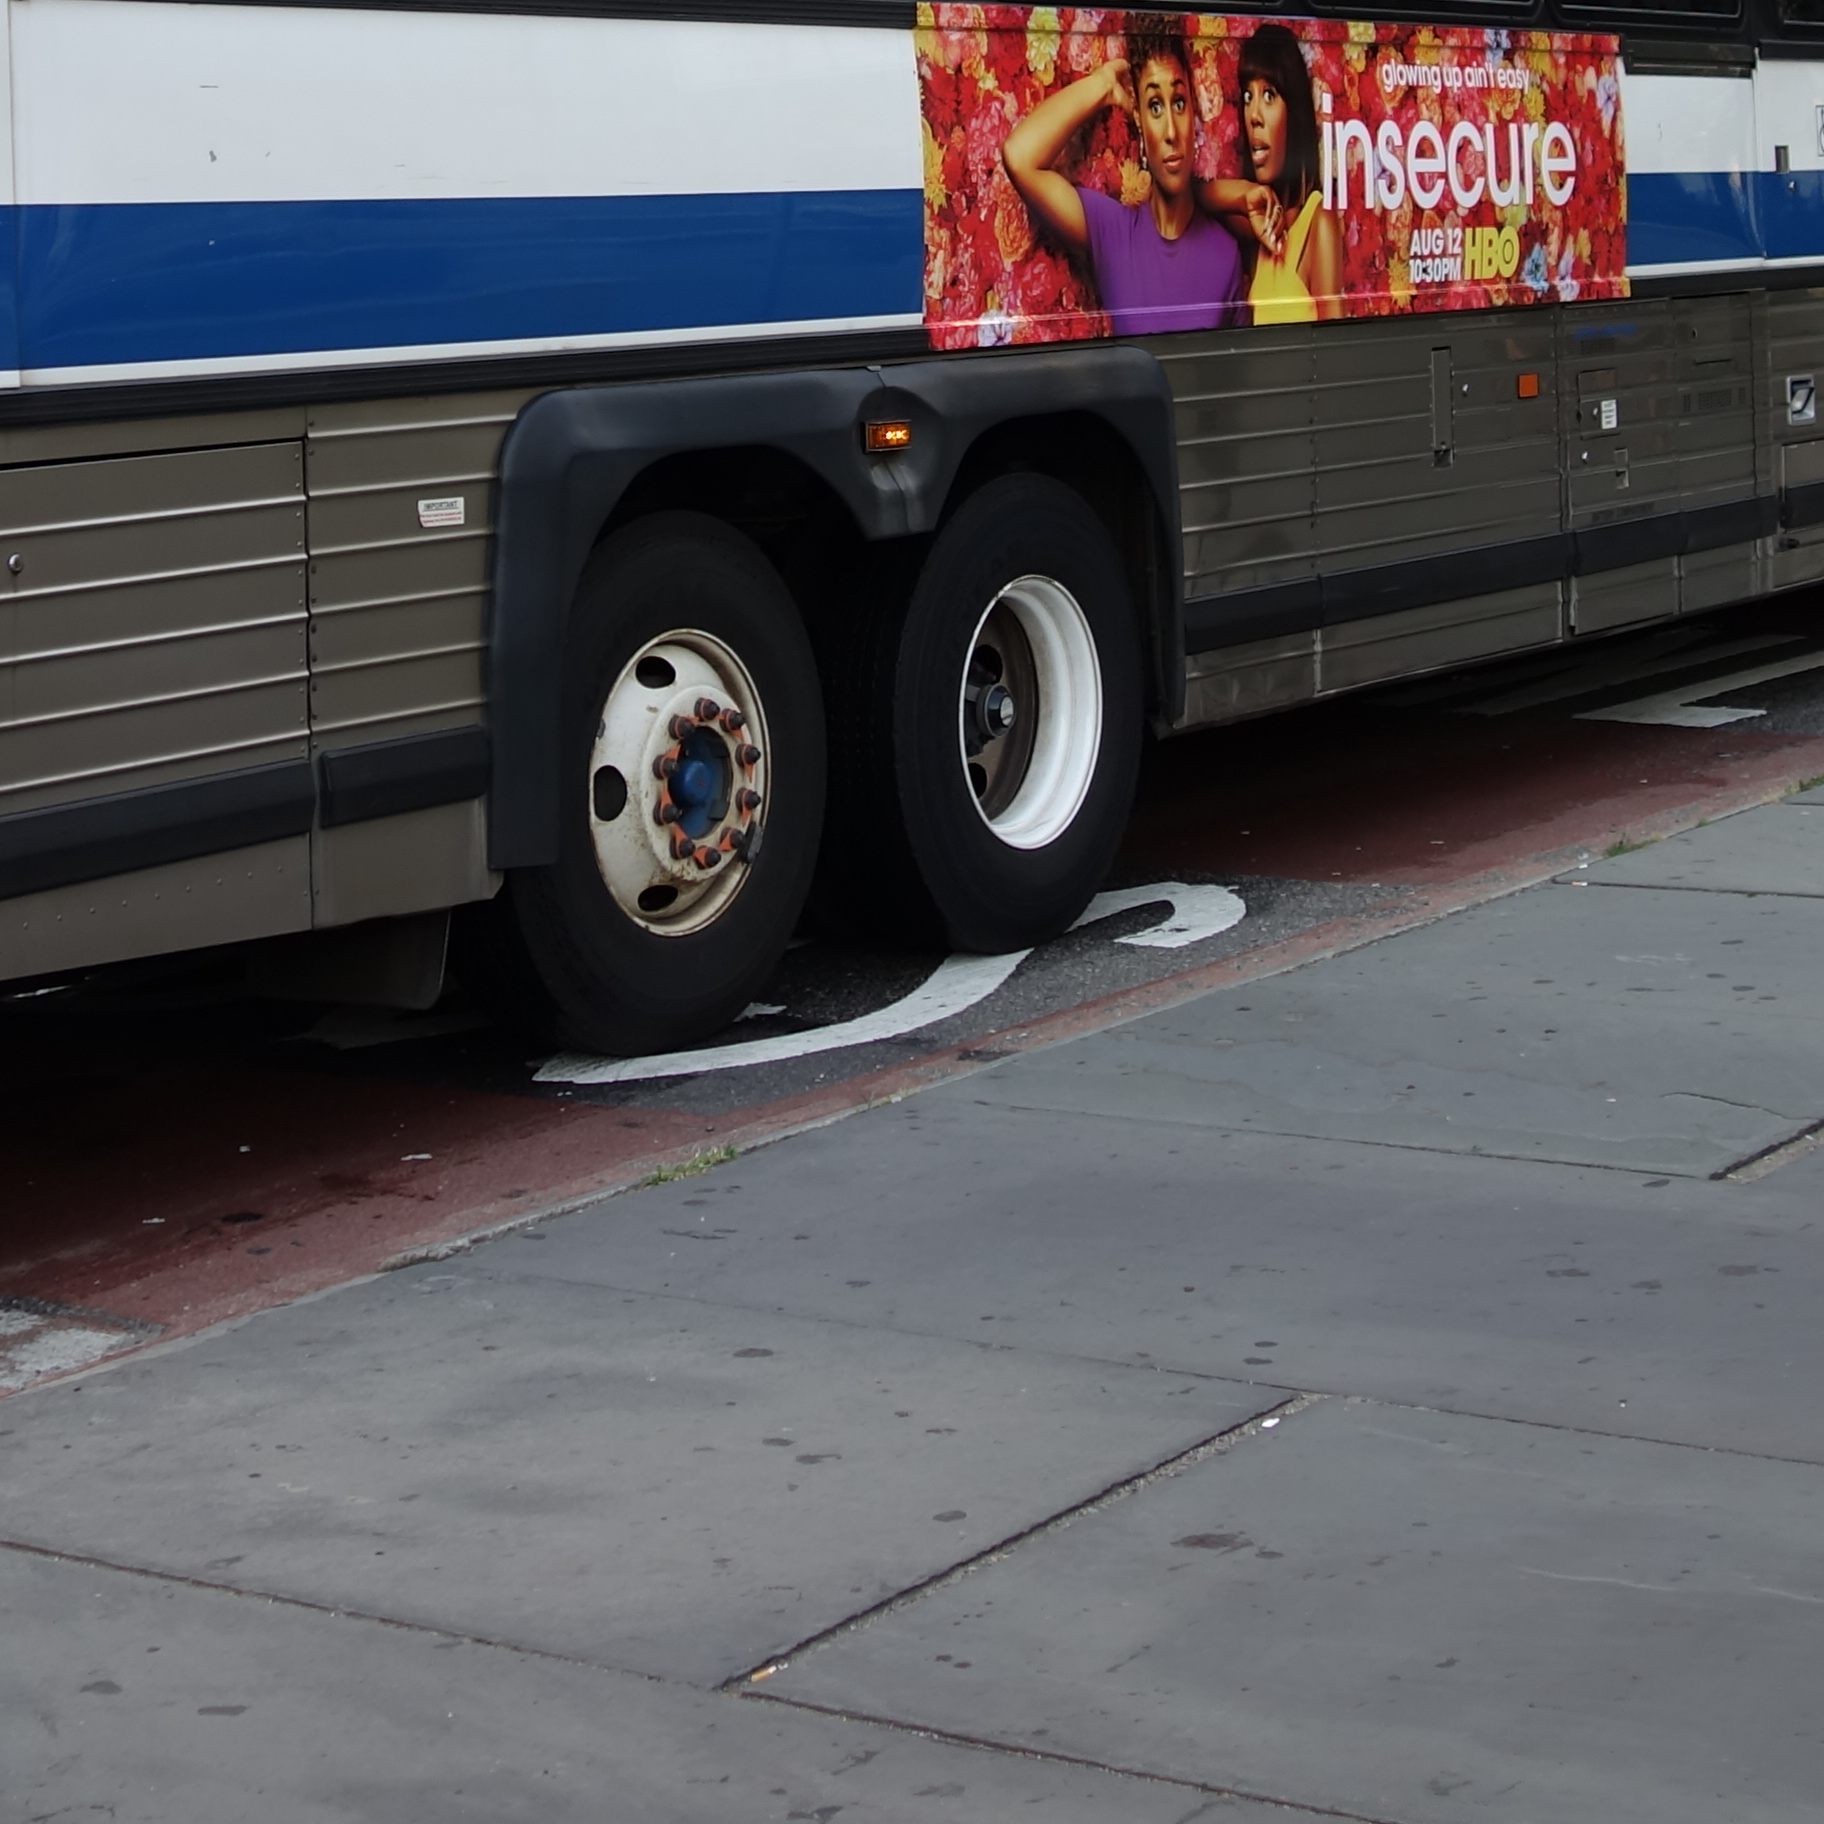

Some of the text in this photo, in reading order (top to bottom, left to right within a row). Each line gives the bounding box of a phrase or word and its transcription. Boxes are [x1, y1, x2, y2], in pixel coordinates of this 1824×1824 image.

[1382, 59, 1531, 94] glowing up ain't easy
[1321, 94, 1576, 212] insecure
[1409, 227, 1463, 257] AUG 12
[1464, 226, 1519, 280] HBO
[1409, 256, 1463, 283] 10:30PM
